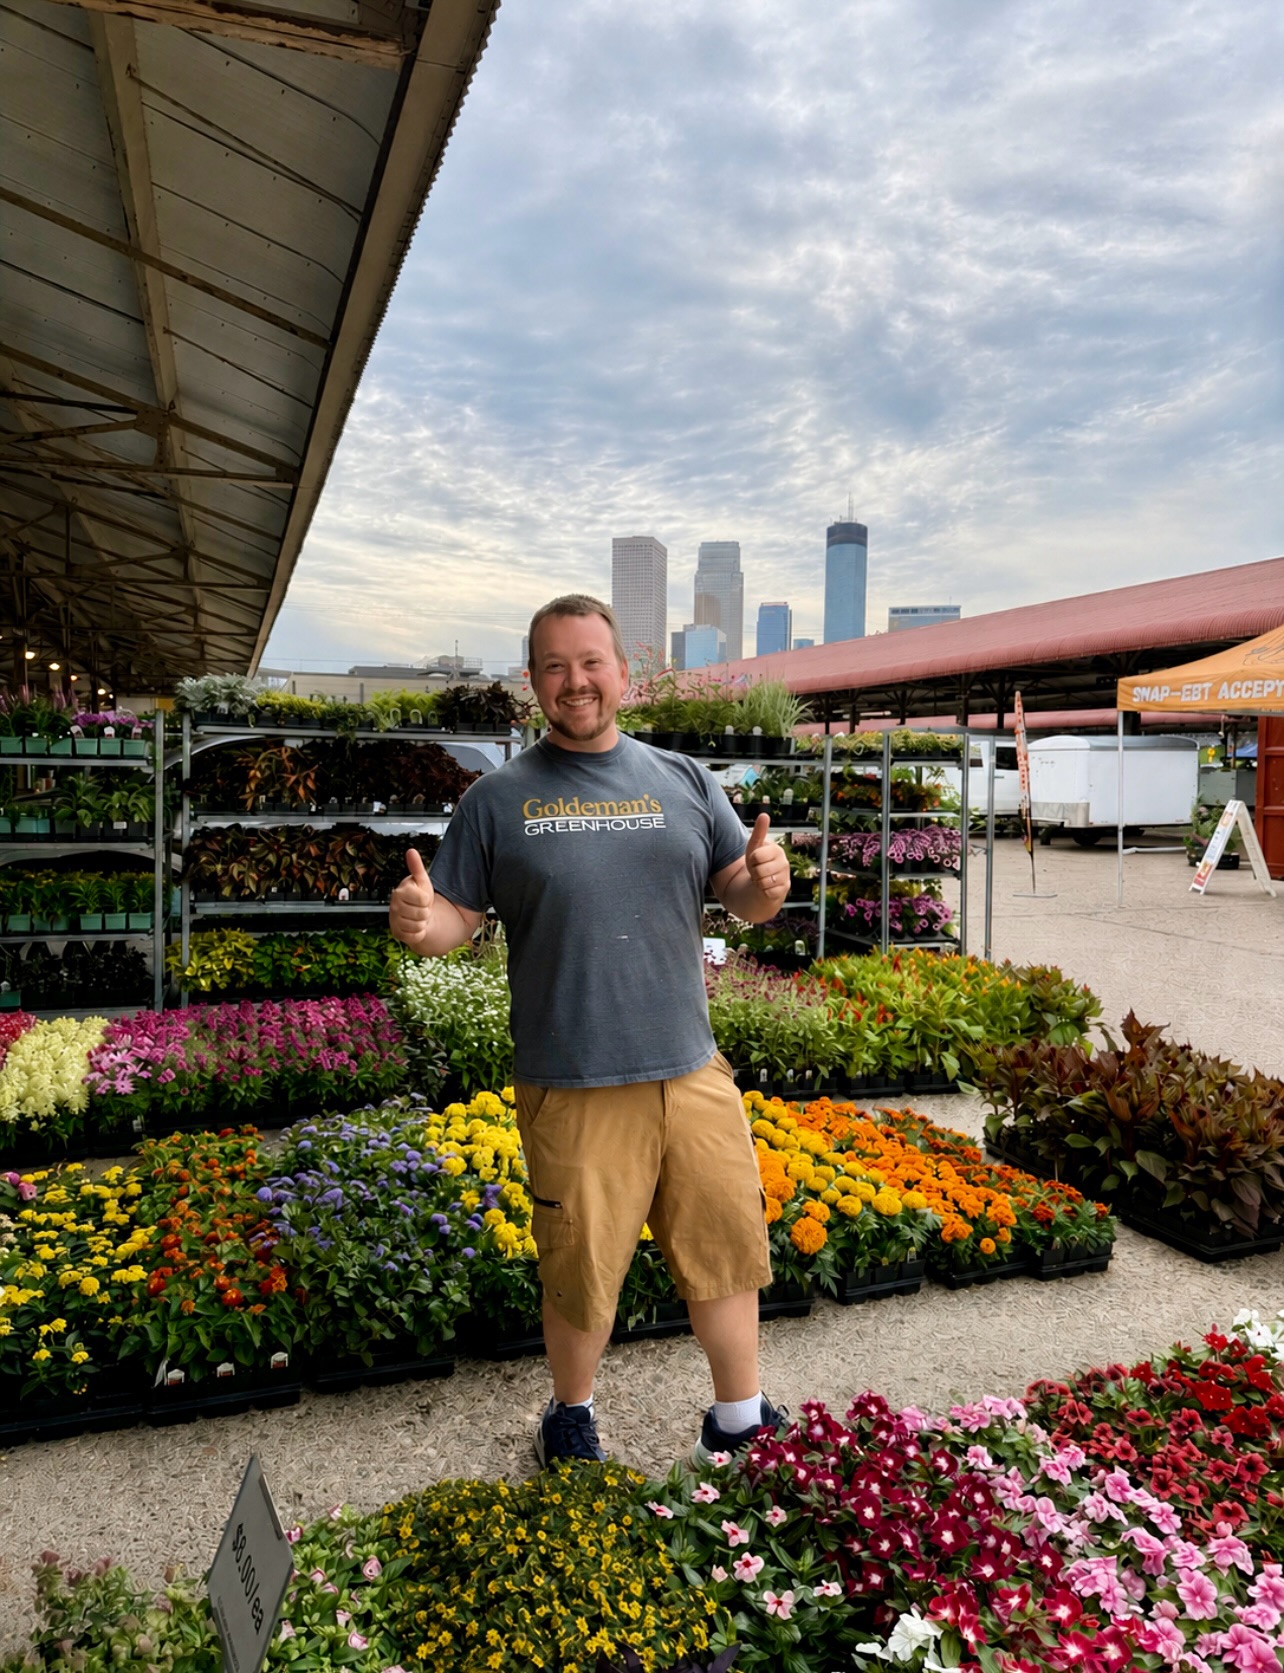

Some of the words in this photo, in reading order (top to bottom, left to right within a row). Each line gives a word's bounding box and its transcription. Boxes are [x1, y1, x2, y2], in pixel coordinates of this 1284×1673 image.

[522, 793, 662, 819] Goldeman's
[524, 817, 666, 836] GREENHOUSE
[232, 1523, 265, 1635] $8.00/ea
